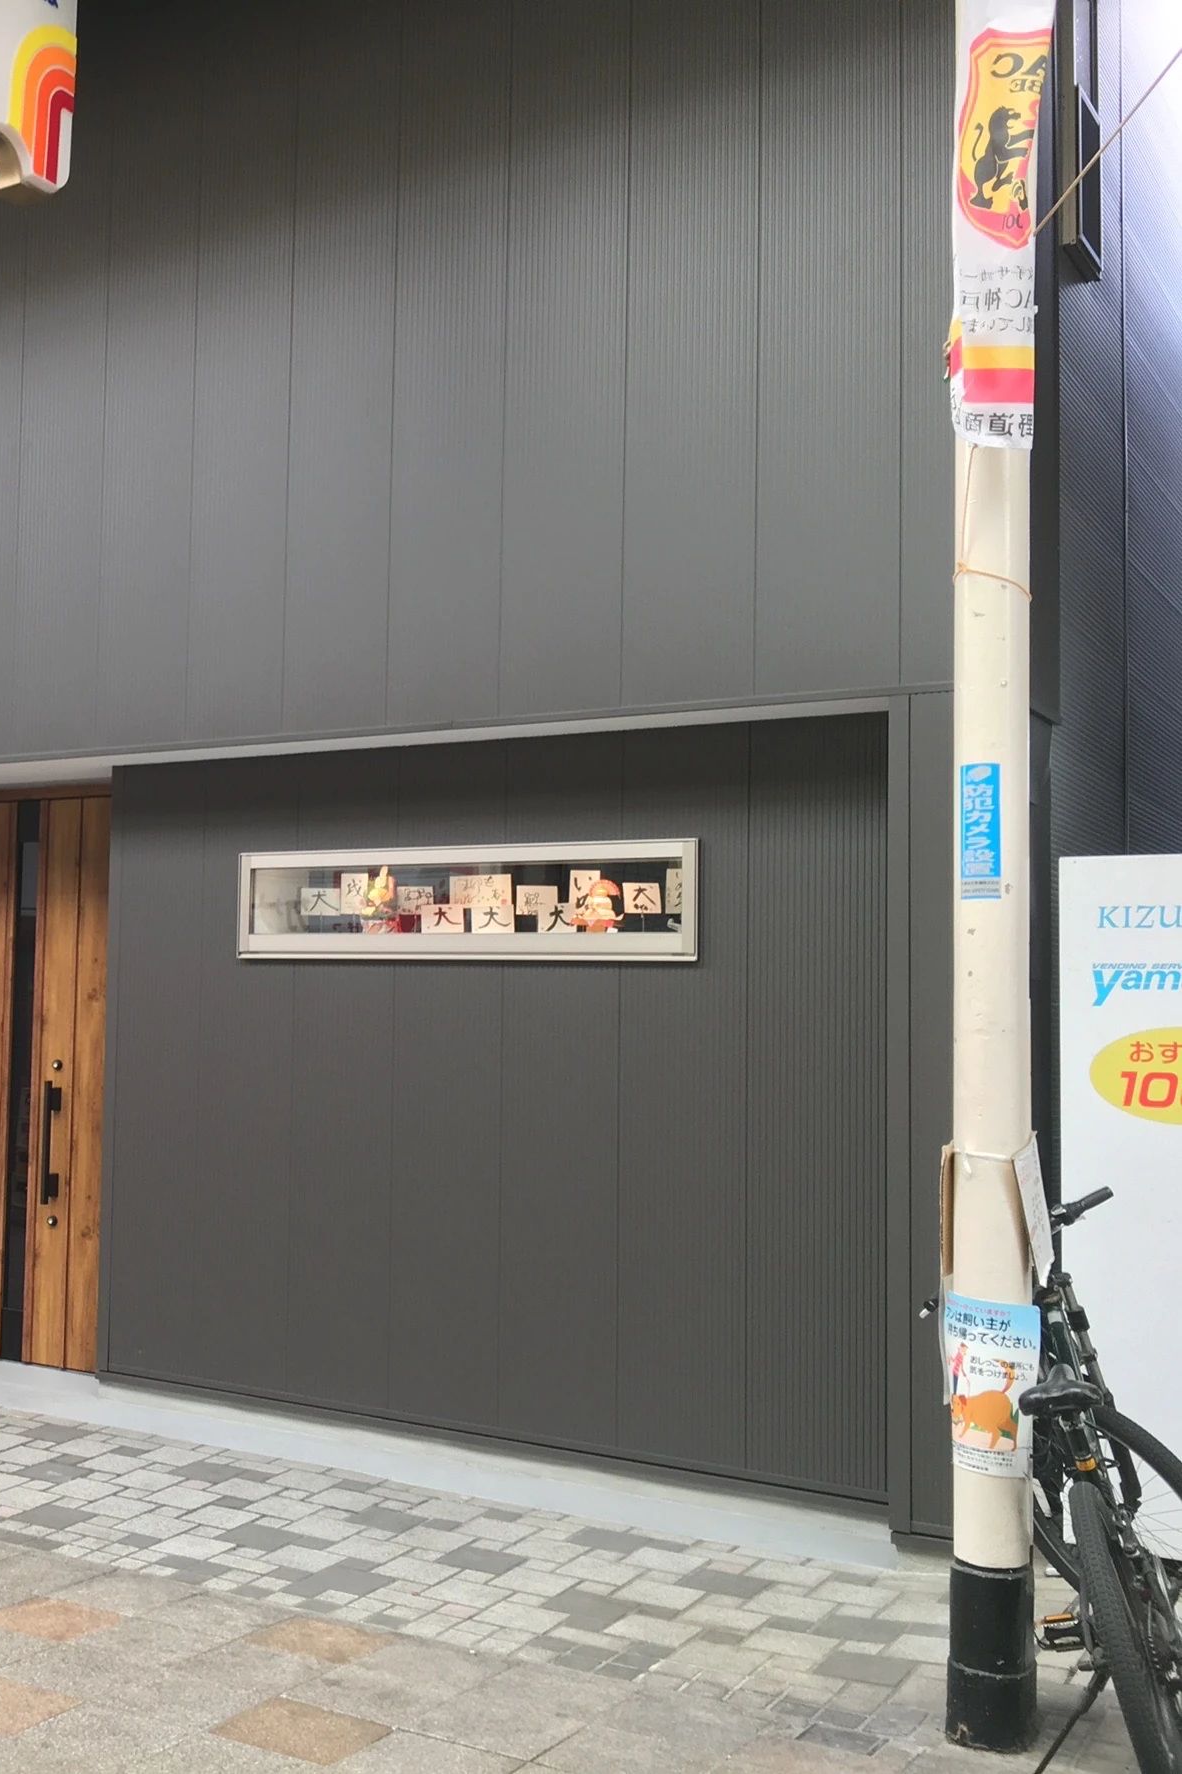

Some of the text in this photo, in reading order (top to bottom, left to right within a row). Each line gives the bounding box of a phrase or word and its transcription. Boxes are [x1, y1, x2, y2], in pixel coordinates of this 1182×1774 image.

[308, 890, 339, 912] 犬
[433, 906, 462, 927] 犬
[479, 906, 511, 929] 犬
[1092, 962, 1147, 970] VENDING
[1092, 970, 1182, 1006] yam
[1120, 1071, 1182, 1108] 10
